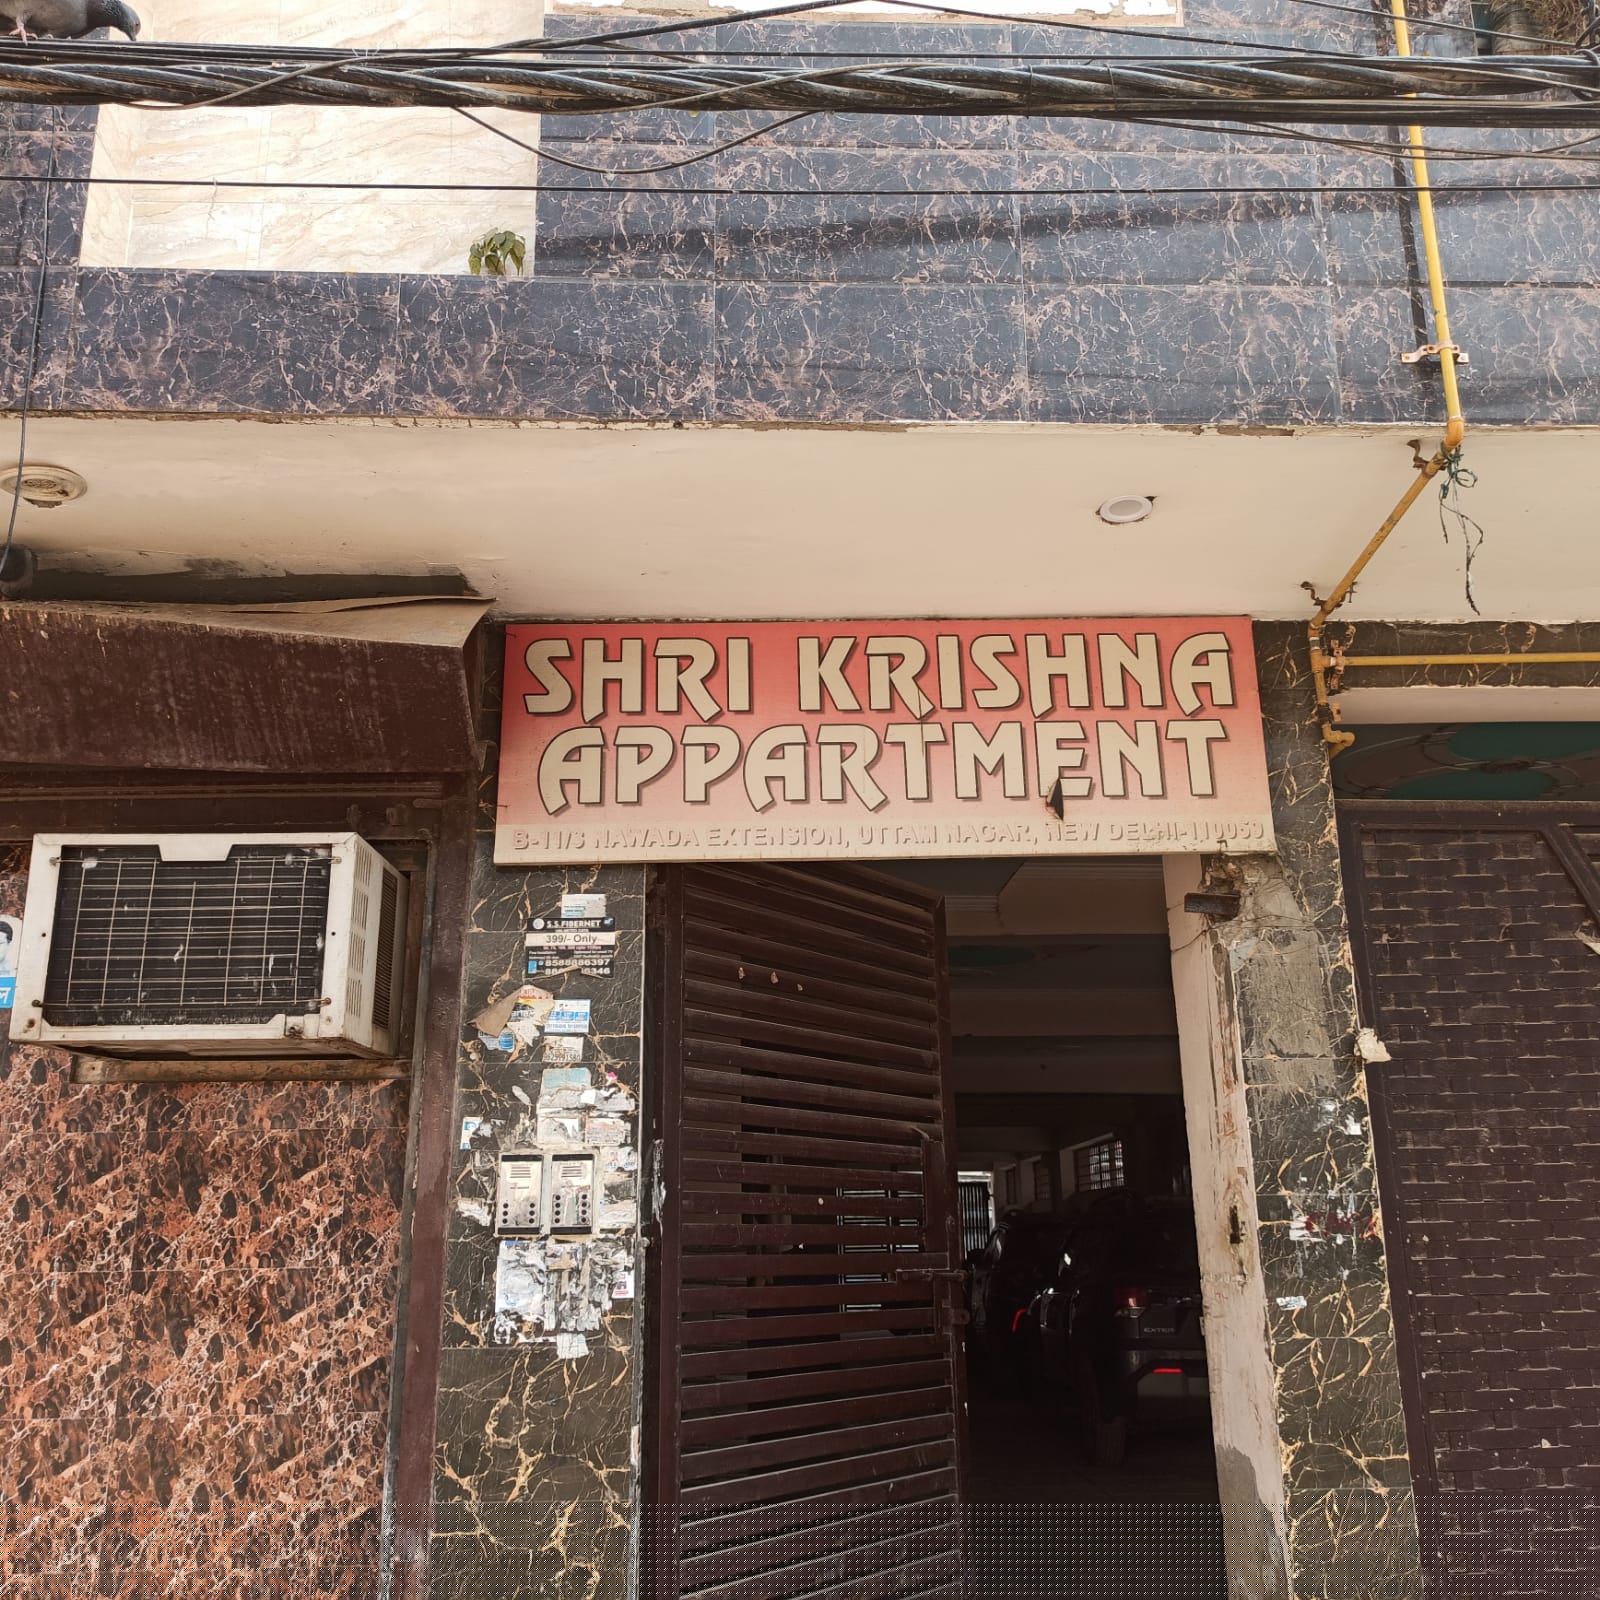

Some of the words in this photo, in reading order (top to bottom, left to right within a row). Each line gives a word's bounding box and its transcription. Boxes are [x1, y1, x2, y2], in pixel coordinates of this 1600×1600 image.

[523, 637, 752, 723] SHRI
[797, 632, 1234, 720] KRISHNA
[537, 719, 1228, 816] APPARTMENT
[594, 827, 700, 849] NAWADA
[859, 823, 938, 845] UTTAM
[1046, 822, 1100, 842] NEW
[573, 934, 597, 945] Only
